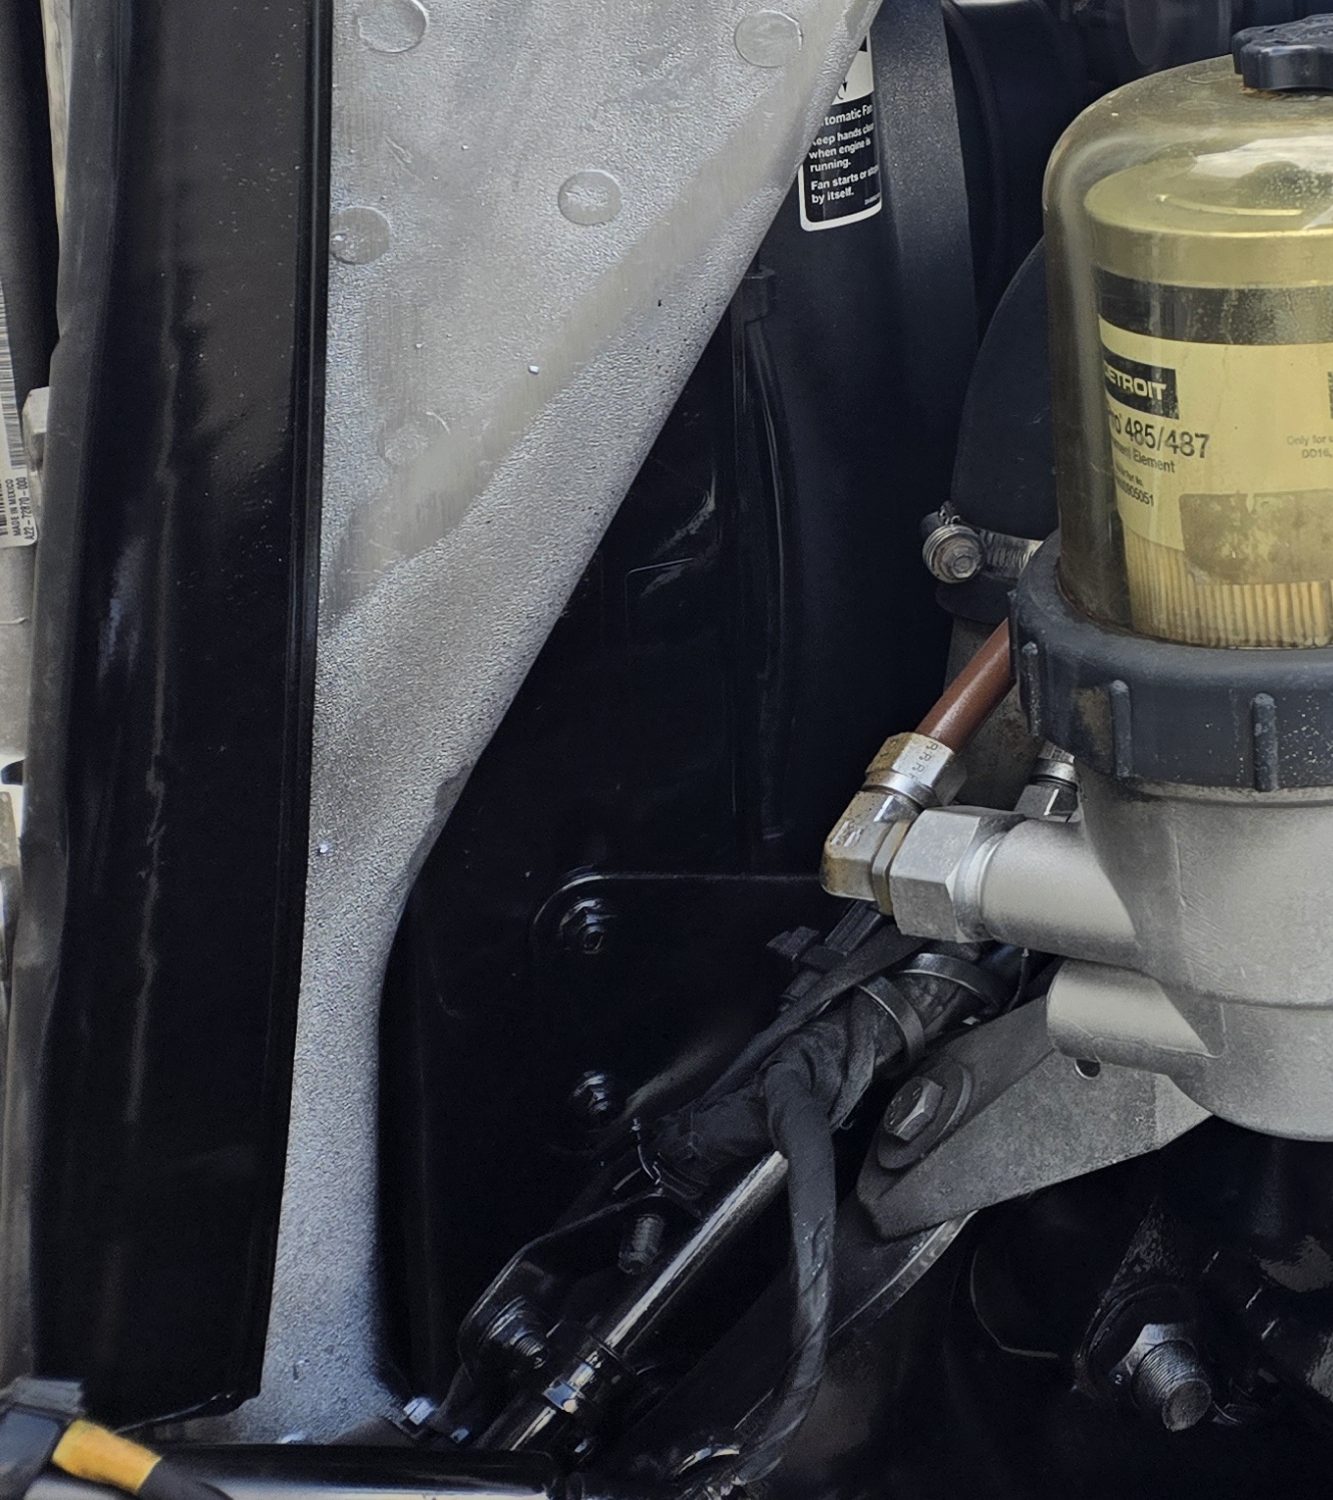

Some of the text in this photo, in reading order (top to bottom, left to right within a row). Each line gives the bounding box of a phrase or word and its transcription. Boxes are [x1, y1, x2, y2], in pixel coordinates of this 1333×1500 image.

[837, 127, 862, 143] hands
[809, 147, 837, 160] when
[838, 140, 865, 155] engine
[810, 157, 852, 173] running.
[810, 179, 831, 191] Fan
[832, 172, 859, 187] starts
[811, 193, 825, 205] by
[826, 186, 855, 201] itself.
[1124, 417, 1211, 459] 485/487
[1286, 435, 1310, 447] Only
[1312, 434, 1326, 444] for
[1133, 448, 1176, 474] Element
[5, 478, 22, 538] MADE IN MEXICO
